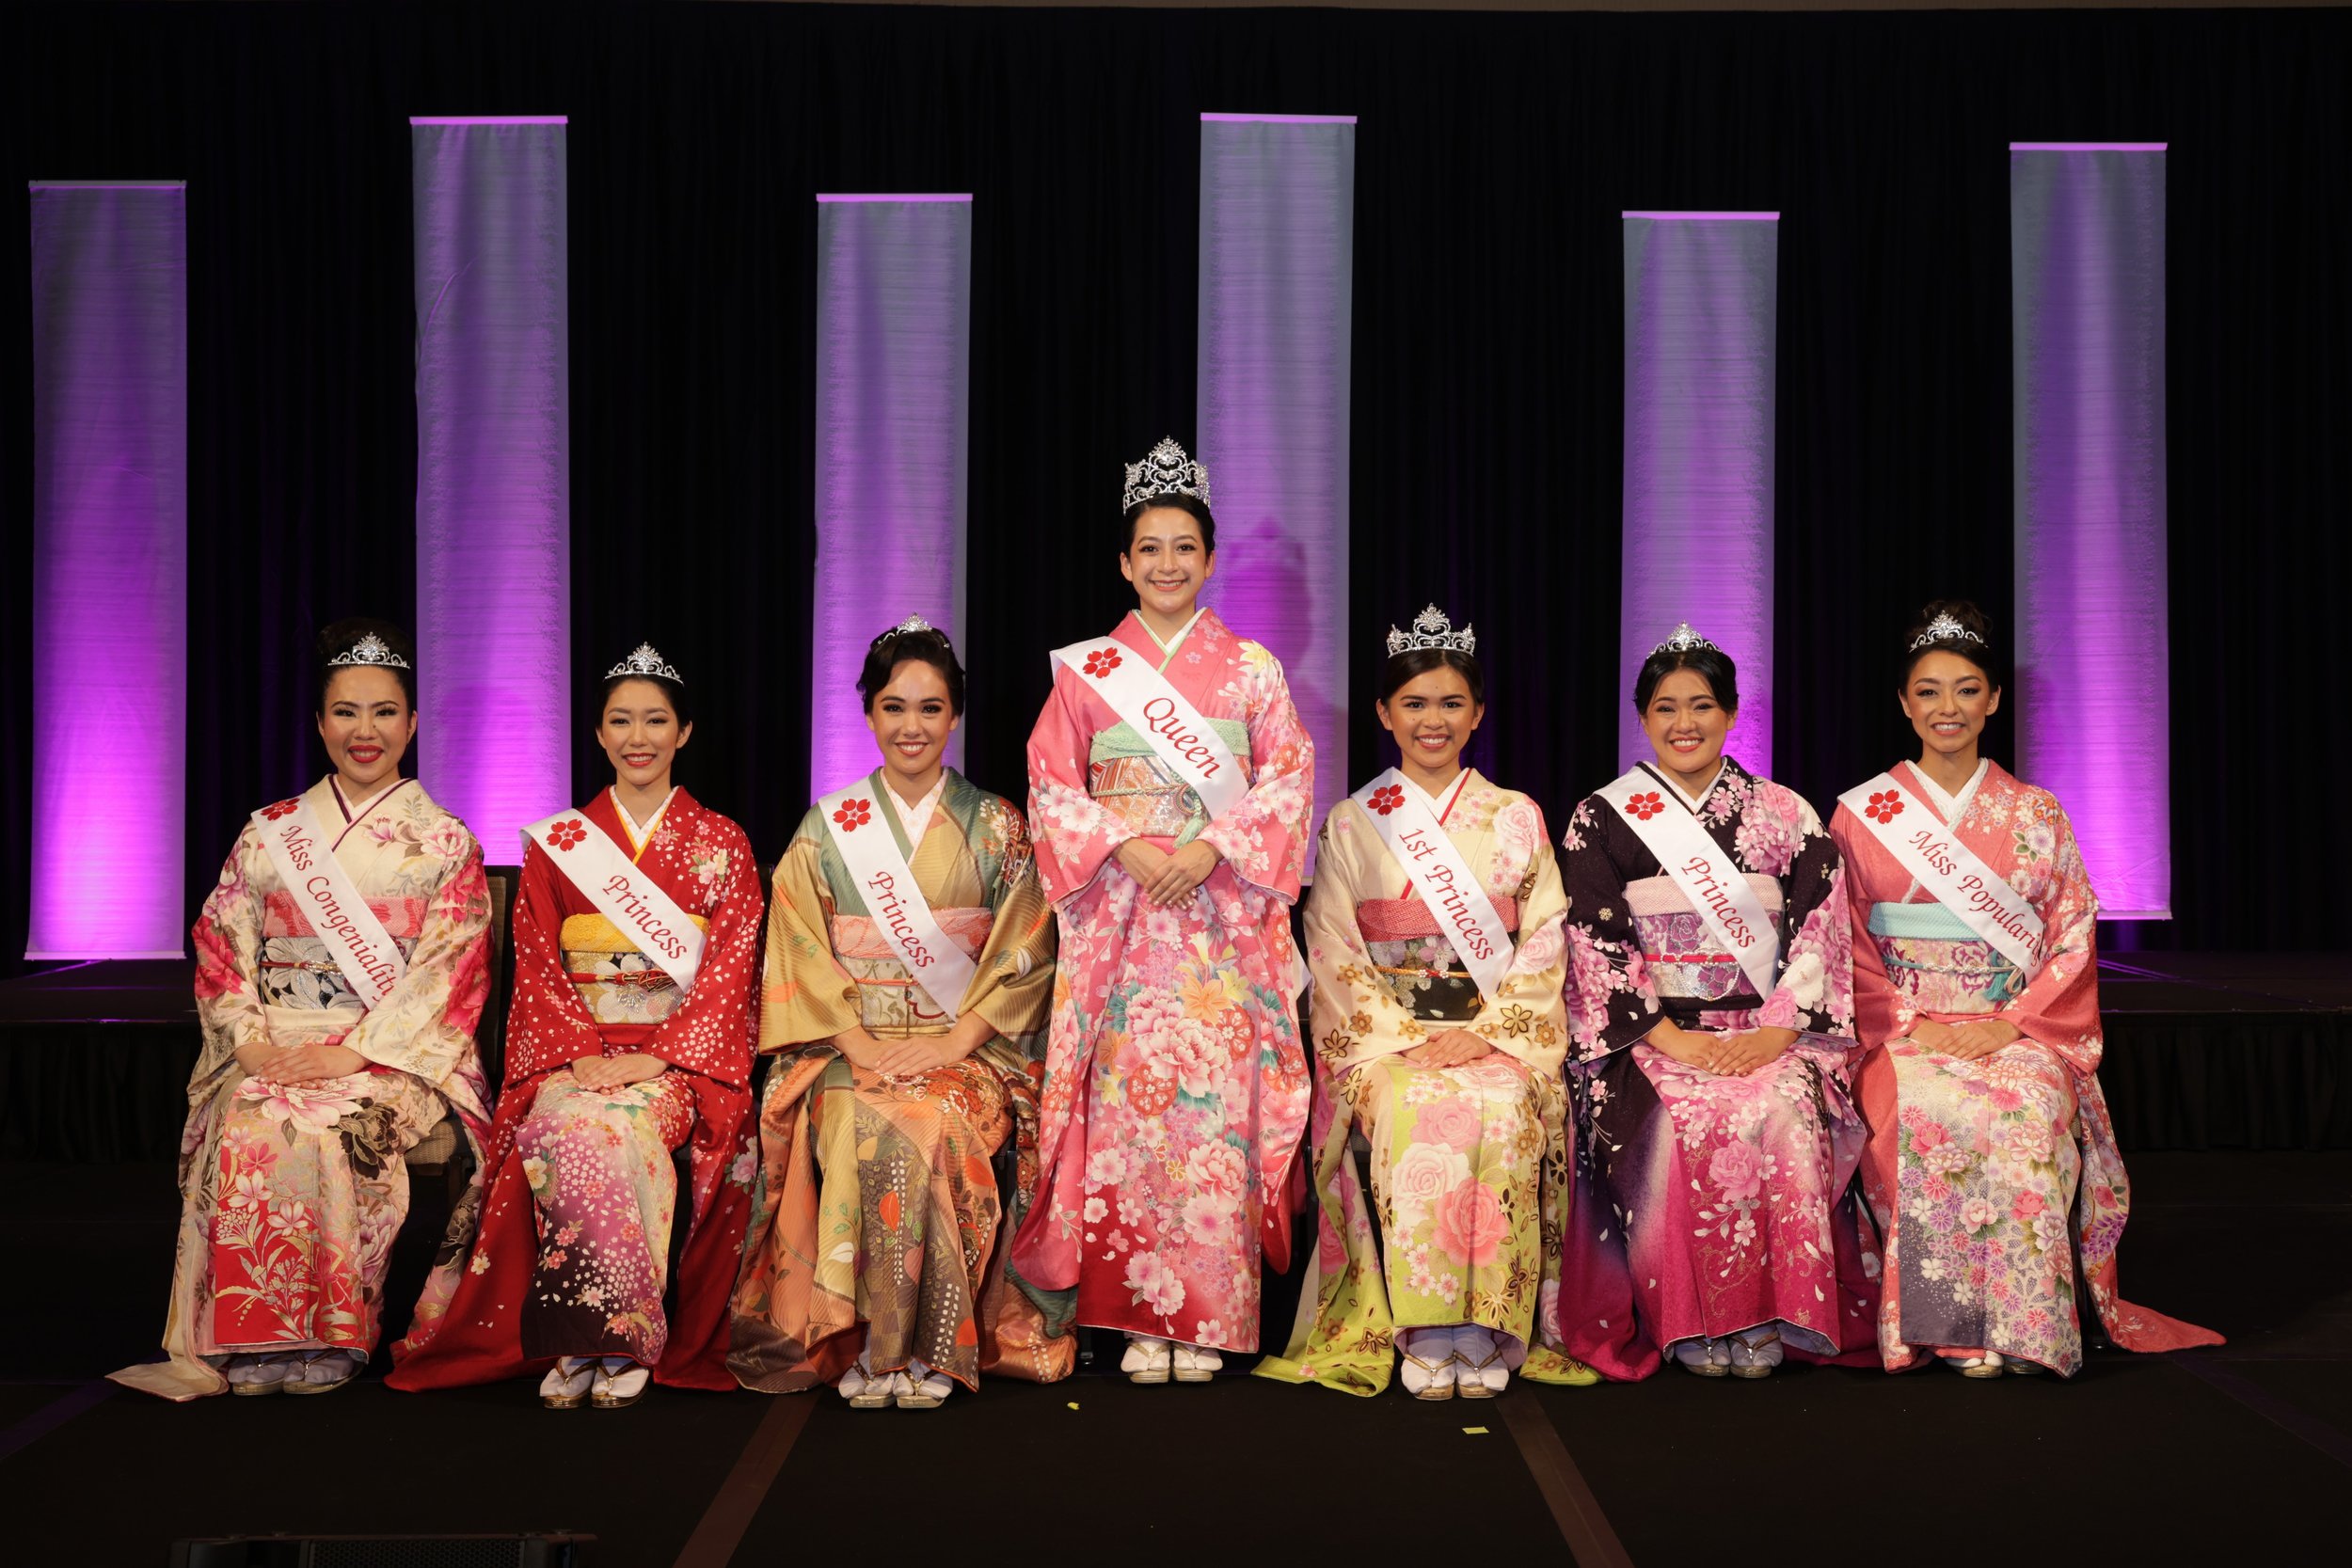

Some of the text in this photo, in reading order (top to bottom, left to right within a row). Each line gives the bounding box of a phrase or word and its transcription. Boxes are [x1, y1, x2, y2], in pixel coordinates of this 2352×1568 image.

[1143, 697, 1220, 779] Queen
[279, 825, 313, 871] Miss
[1908, 831, 1957, 876] Miss
[602, 875, 688, 959] Princess
[867, 871, 935, 968] Princess
[1398, 828, 1494, 960] 1st Princess
[1680, 856, 1756, 948] Princess
